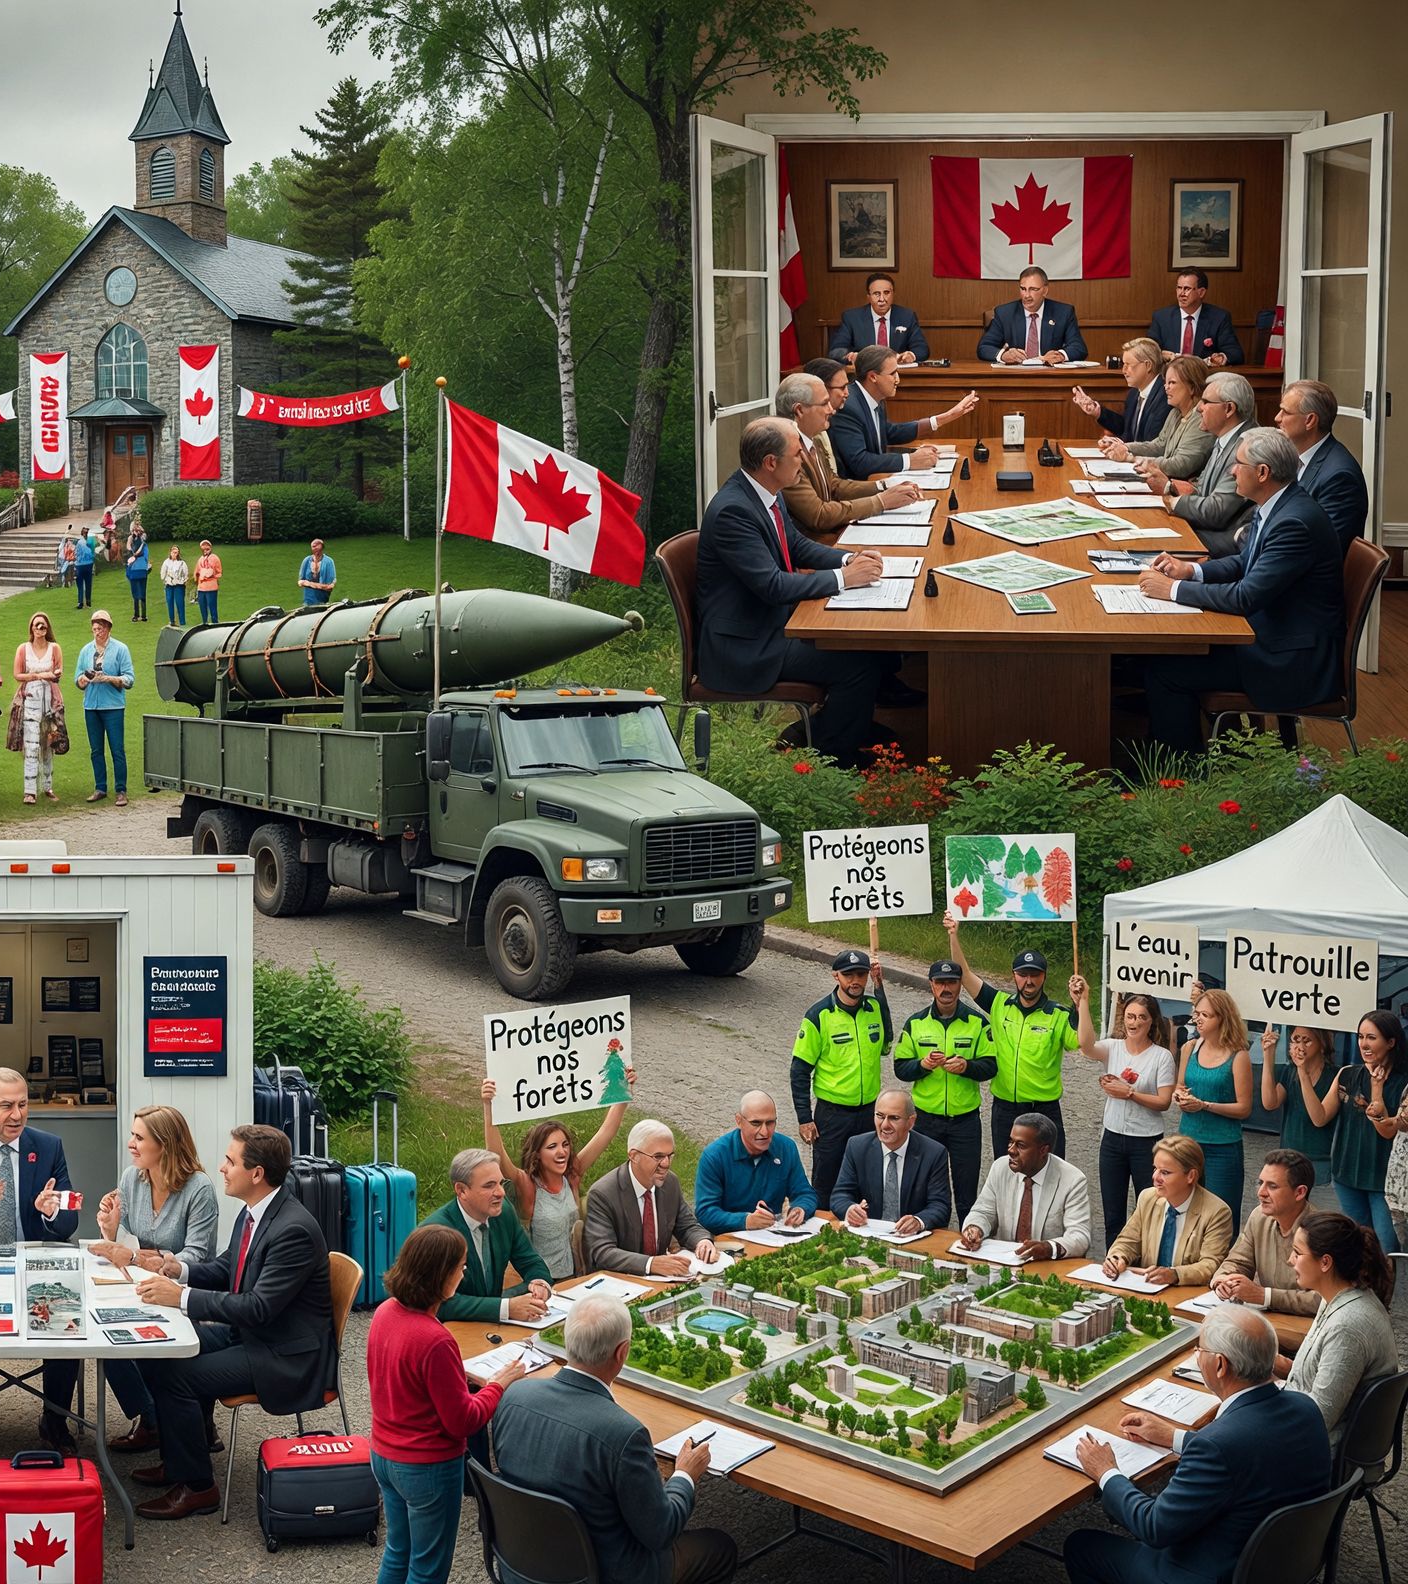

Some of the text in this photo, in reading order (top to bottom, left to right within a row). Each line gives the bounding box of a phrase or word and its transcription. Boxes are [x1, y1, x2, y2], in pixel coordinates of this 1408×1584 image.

[809, 834, 924, 865] Protégeons
[847, 866, 886, 884] nos
[829, 885, 904, 912] forêts
[1115, 921, 1190, 961] L'eau,
[1233, 936, 1370, 981] Patrouille
[1117, 962, 1193, 988] avenir
[1261, 983, 1341, 1016] verte
[490, 1010, 625, 1051] Protégeons
[537, 1050, 579, 1075] nos
[512, 1073, 593, 1112] forêts
